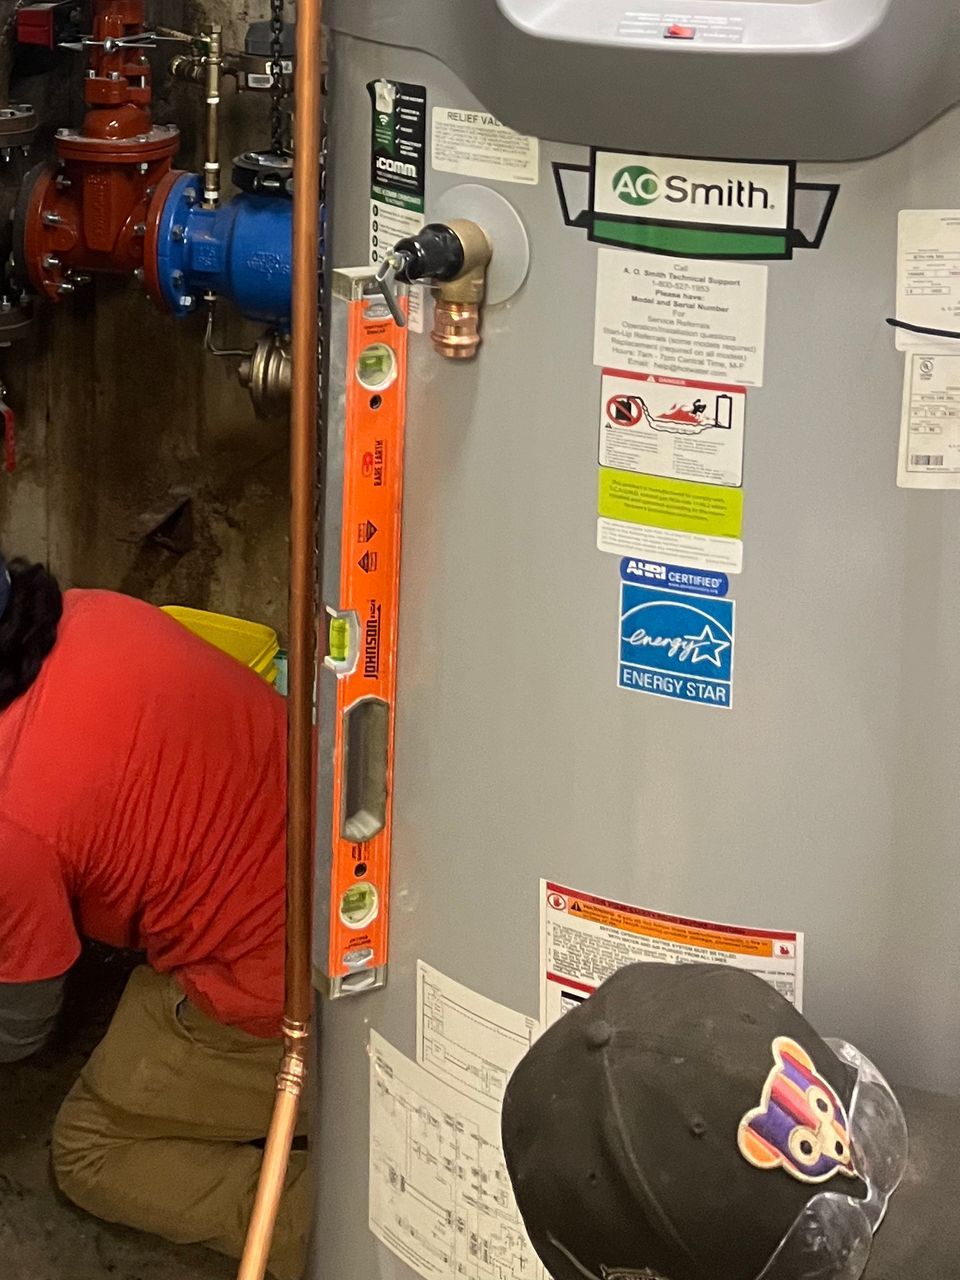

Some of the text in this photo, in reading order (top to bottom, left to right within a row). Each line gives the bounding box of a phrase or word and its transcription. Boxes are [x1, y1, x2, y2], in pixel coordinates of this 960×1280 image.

[447, 112, 479, 123] RELIEF
[664, 175, 768, 209] Smith
[673, 264, 688, 272] Call
[644, 270, 666, 279] Smith
[669, 272, 706, 284] Technical
[708, 276, 741, 287] Support
[631, 295, 729, 313] Model and Serial Number
[655, 289, 705, 302] Please have:
[648, 315, 675, 326] Service
[672, 310, 685, 318] For
[668, 336, 692, 346] (some
[693, 339, 721, 350] models
[700, 332, 737, 342] questions
[611, 337, 658, 351] Replacement
[705, 350, 715, 358] all
[612, 347, 636, 357] Hours:
[677, 356, 705, 366] Central
[626, 560, 720, 588] AHRI CERTIFIED
[364, 619, 378, 681] JOHNSON
[623, 628, 702, 661] energy
[623, 668, 726, 702] ENERGY STAR
